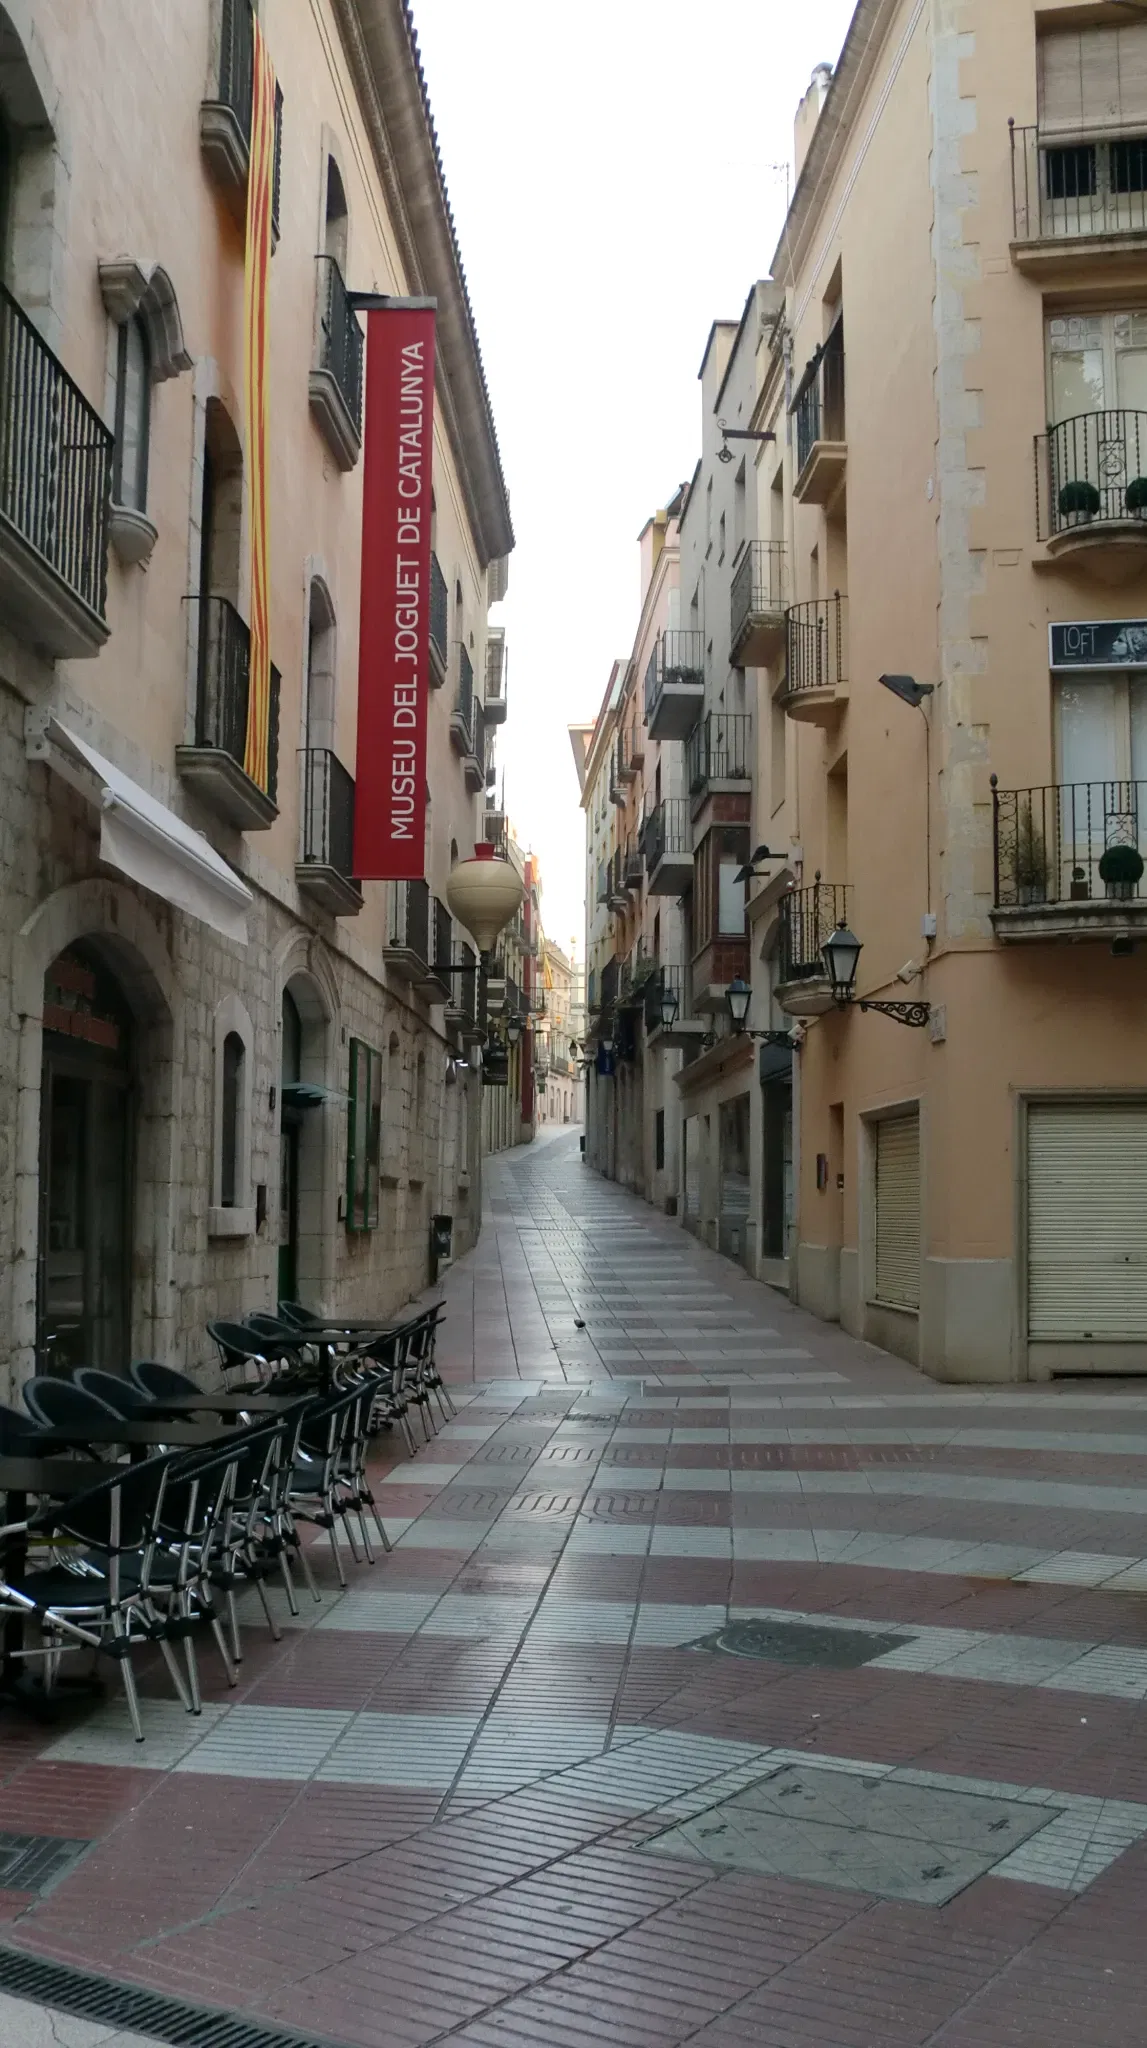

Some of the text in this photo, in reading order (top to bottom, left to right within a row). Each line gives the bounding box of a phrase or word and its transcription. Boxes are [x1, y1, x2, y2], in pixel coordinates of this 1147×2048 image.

[391, 341, 425, 840] MUSEU DEL JOGUET DE CATALUNYA
[1063, 625, 1099, 656] LOFT
